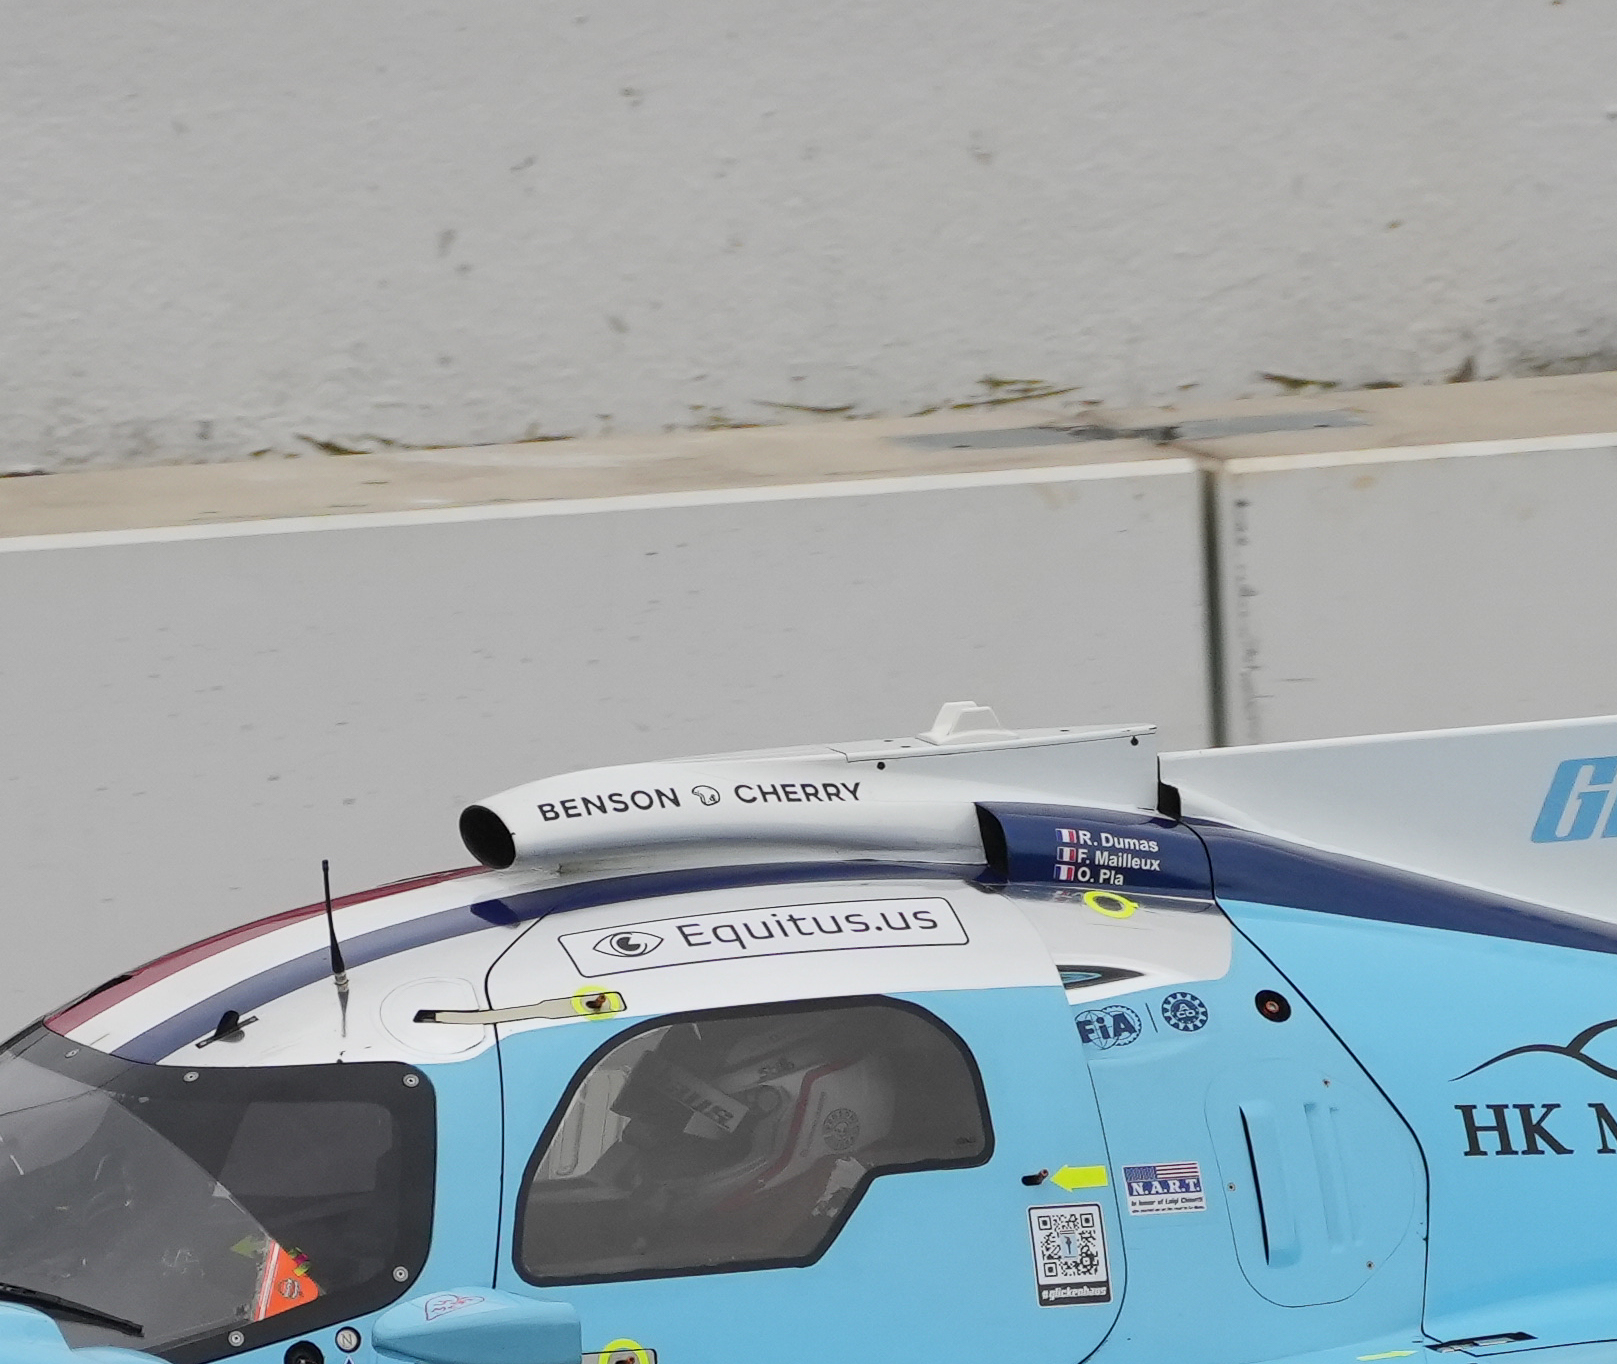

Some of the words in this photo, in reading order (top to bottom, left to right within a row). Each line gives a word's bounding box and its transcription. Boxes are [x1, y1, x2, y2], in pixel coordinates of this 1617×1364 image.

[537, 788, 680, 822] BENSON
[734, 781, 862, 804] CHERRY
[1078, 830, 1097, 846] R.
[1101, 833, 1159, 852] Dumas
[1077, 849, 1090, 864] F.
[1095, 852, 1161, 871] Mailleux
[1077, 868, 1095, 882] O.
[1099, 869, 1124, 885] Pla
[677, 902, 938, 949] Equitus.us
[1454, 1102, 1573, 1158] HK
[1130, 1179, 1200, 1196] N.A.R.T.
